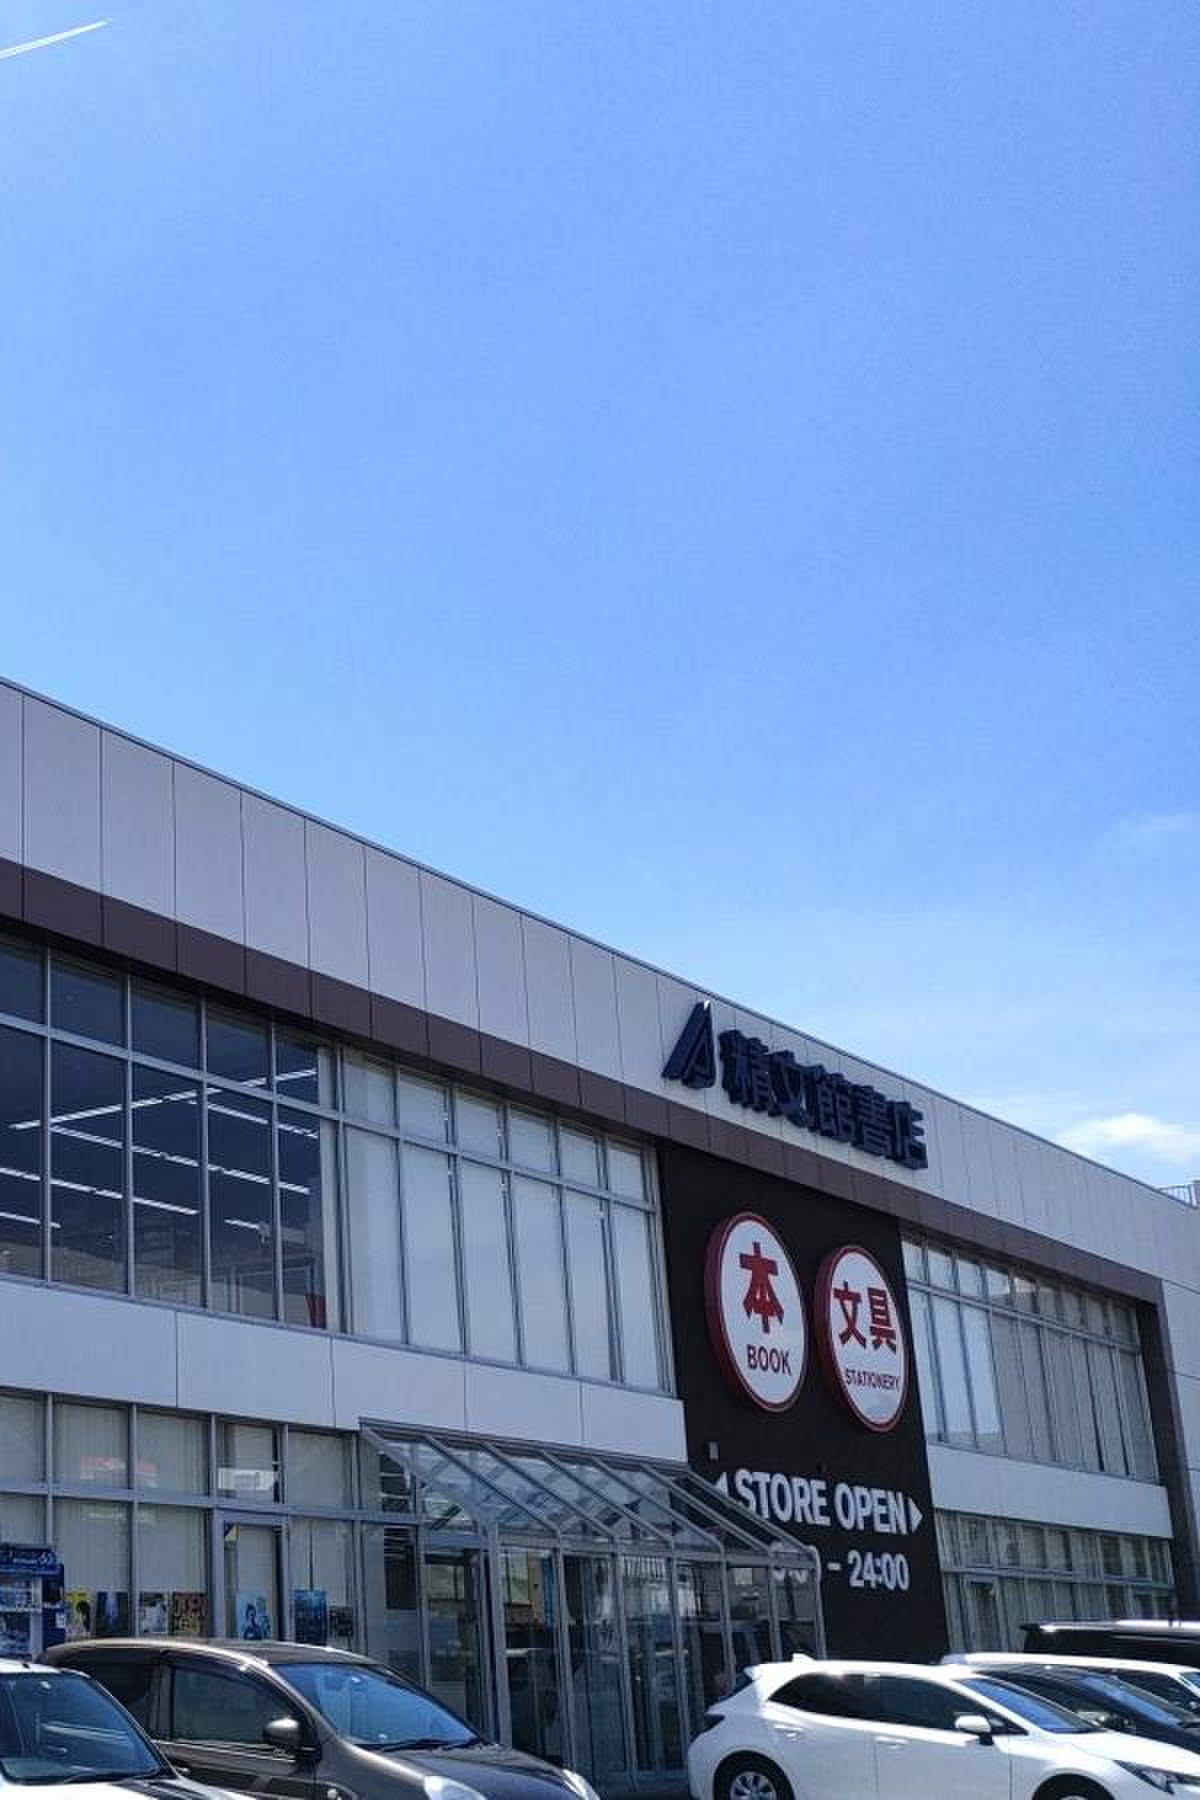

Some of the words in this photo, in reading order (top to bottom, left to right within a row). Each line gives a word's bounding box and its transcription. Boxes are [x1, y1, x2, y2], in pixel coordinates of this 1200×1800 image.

[738, 1241, 784, 1334] 本
[833, 1281, 898, 1354] 文具
[746, 1343, 792, 1376] BOOK
[845, 1367, 900, 1390] STATIONERY
[735, 1468, 831, 1526] STORE
[834, 1482, 908, 1535] OPEN
[847, 1550, 910, 1591] 24:00
